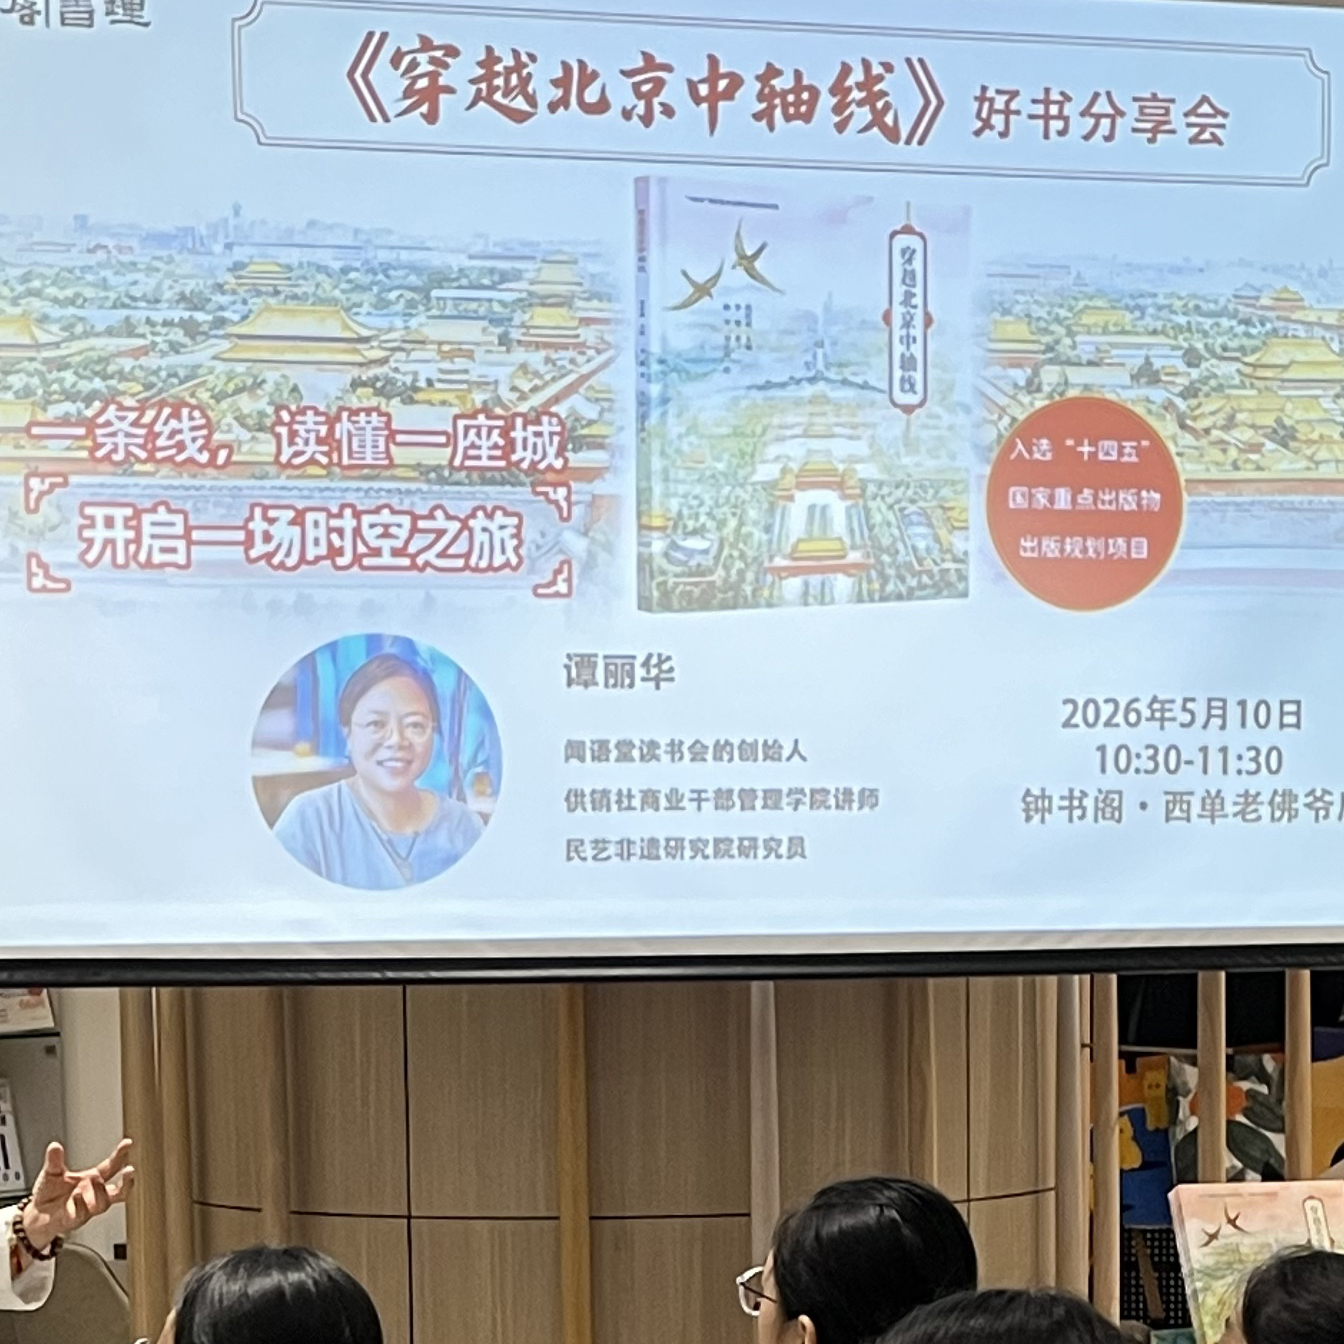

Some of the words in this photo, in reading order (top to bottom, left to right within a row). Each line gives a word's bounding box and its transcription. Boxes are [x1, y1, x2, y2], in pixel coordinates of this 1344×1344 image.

[346, 30, 945, 147] 《穿越北京中轴线》
[972, 84, 1232, 148] 好书分享会
[28, 405, 568, 472] 一条线，读懂一座城
[1008, 486, 1161, 514] 国家重点出版物
[80, 503, 524, 572] 开启一场时空之旅
[1019, 534, 1149, 562] 出版规划项目
[563, 652, 676, 692] 谭丽华
[1061, 694, 1304, 731] 2026年5月10日
[563, 738, 808, 765] 闻语堂读书会的创始人
[1095, 743, 1284, 777] 10:30-11:30
[563, 787, 881, 813] 供销社商业干部管理学院讲师
[564, 836, 808, 863] 民艺非遗研究院研究员
